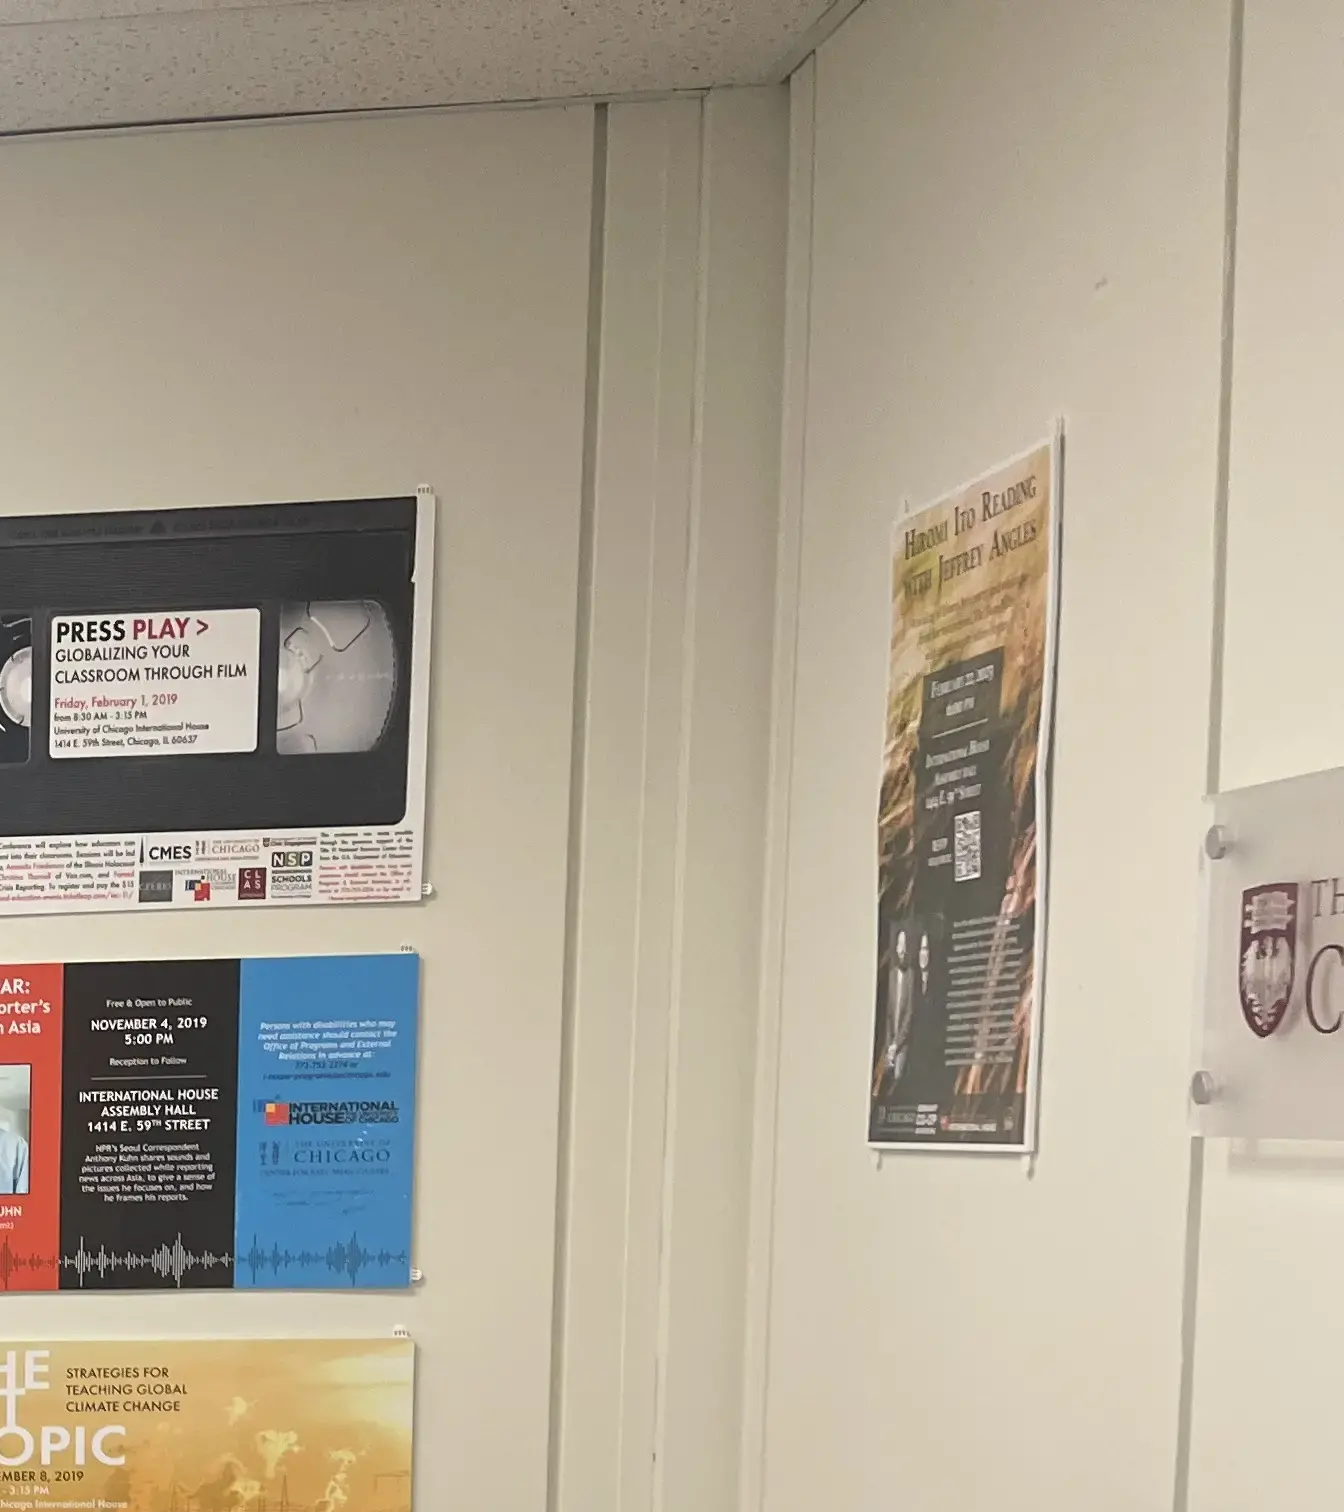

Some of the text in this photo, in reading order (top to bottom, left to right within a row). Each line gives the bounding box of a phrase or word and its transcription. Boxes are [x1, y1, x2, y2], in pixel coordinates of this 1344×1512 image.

[905, 475, 1036, 560] HIROMI ITO READING
[989, 519, 1037, 561] ANGLES
[56, 617, 190, 643] PRESS PLAY
[55, 644, 190, 662] GLOBALIZING YOUR
[55, 664, 247, 684] CLASSROOM THROUGH FILM
[54, 693, 177, 710] Friday, February 1, 2019
[93, 712, 108, 720] AM
[134, 711, 147, 719] PM
[54, 739, 71, 749] 1414
[101, 738, 125, 747] Street,
[127, 736, 160, 747] Chicago,
[171, 735, 197, 745] 60637
[148, 845, 192, 860] CMES
[271, 851, 313, 868] NSP
[106, 998, 192, 1008] Free & Open to Public
[8, 1019, 41, 1034] Asia
[90, 1017, 207, 1031] NOVEMBER 4, 2019
[124, 1033, 173, 1045] 5:00 PM
[109, 1056, 187, 1067] Reception to Follow
[79, 1088, 219, 1103] INTERNATIONAL HOUSE
[101, 1104, 196, 1117] ASSEMBLY HALL
[87, 1118, 211, 1132] 1414 E. 59TH STREET
[67, 1367, 169, 1379] STRATEGIES FOR
[66, 1384, 188, 1396] TEACHING GLOBAL
[66, 1401, 180, 1412] CLIMATE CHANGE
[39, 1471, 50, 1482] 8,
[55, 1471, 84, 1481] 2019
